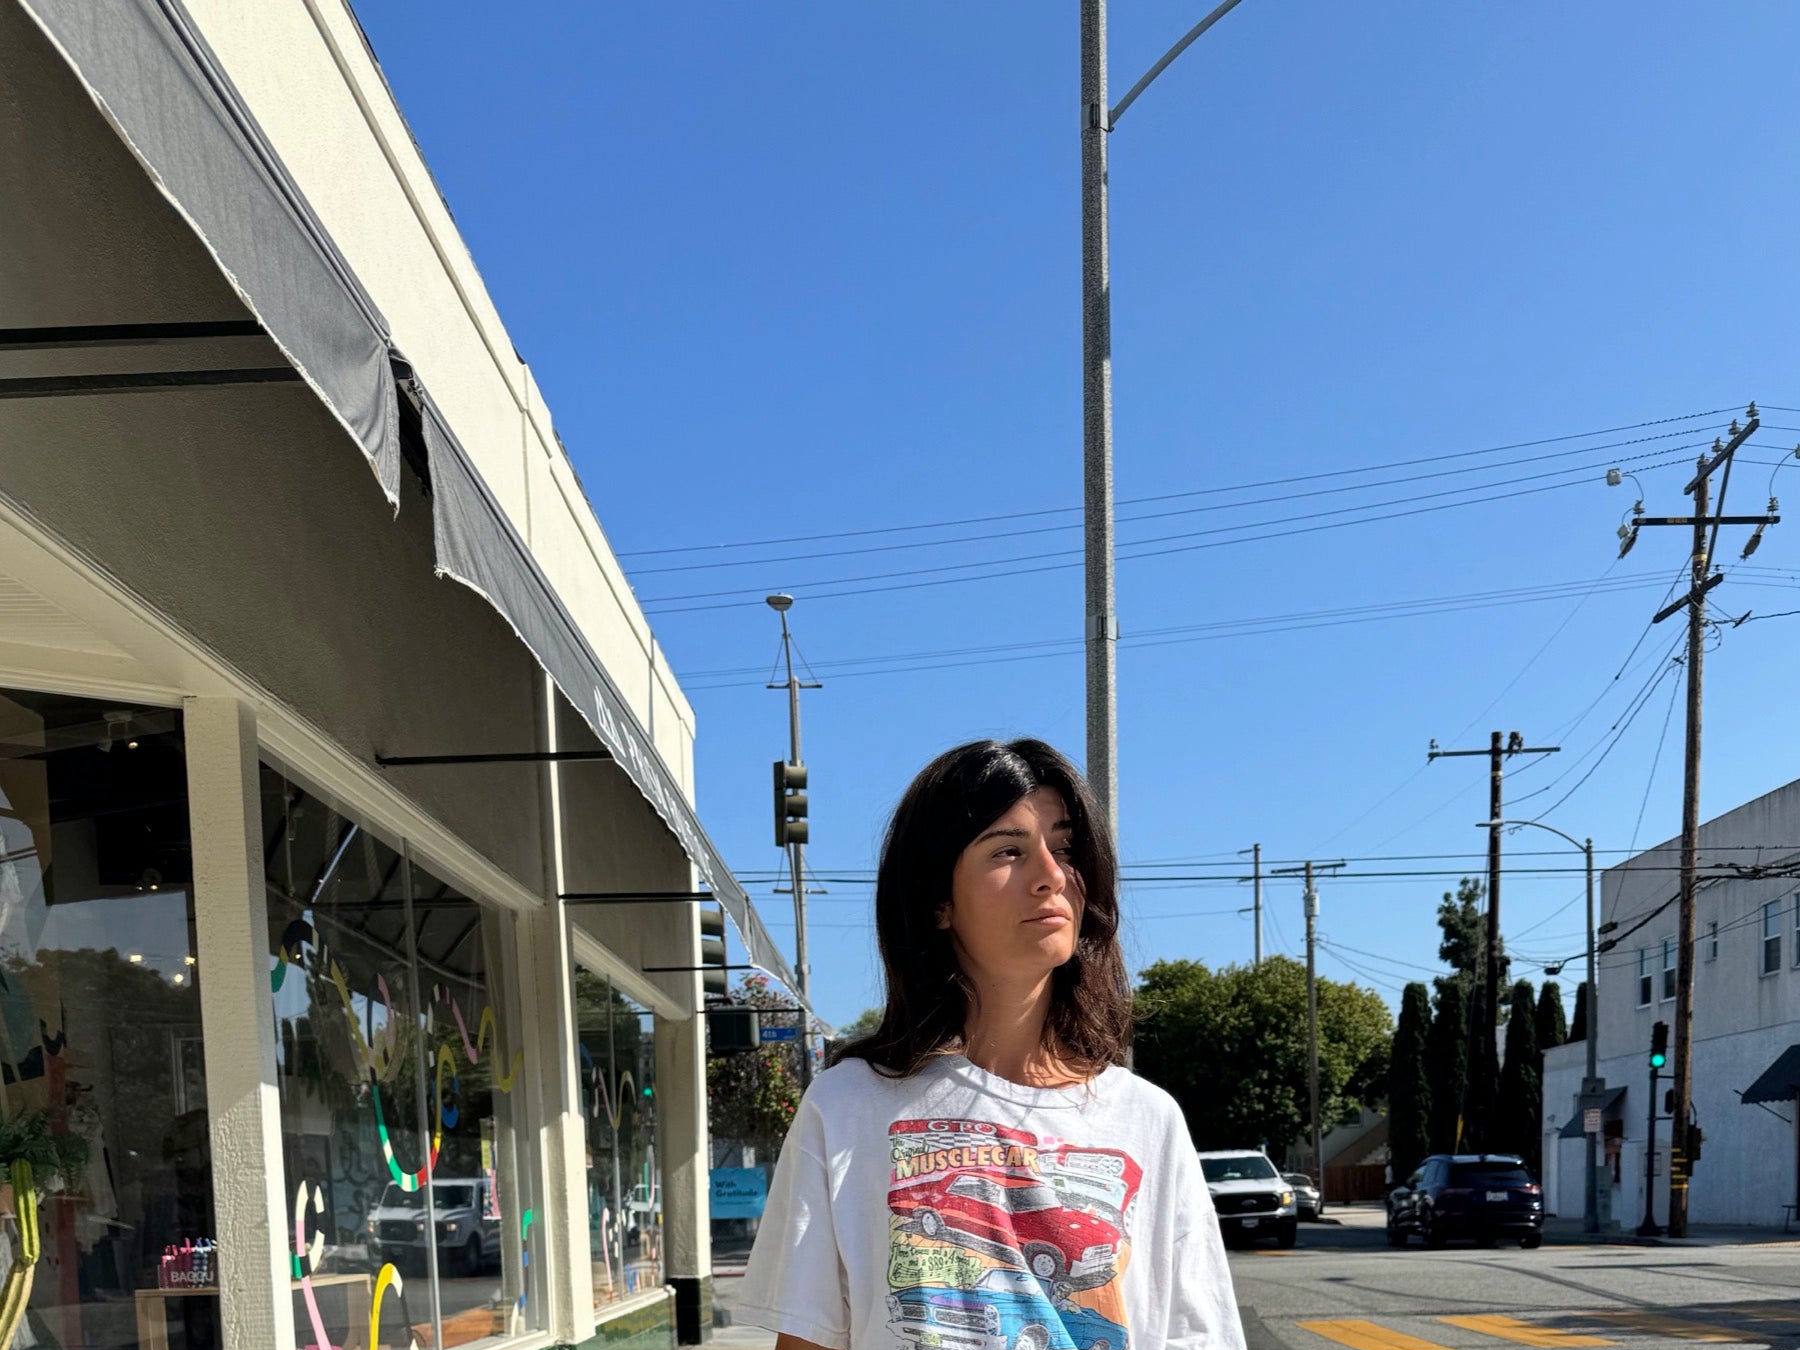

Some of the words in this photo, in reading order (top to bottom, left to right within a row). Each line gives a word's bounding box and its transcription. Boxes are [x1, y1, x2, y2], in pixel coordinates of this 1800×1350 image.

[927, 1120, 998, 1136] GTO
[895, 1144, 1042, 1181] MUSCLECAR
[715, 1181, 737, 1189] With
